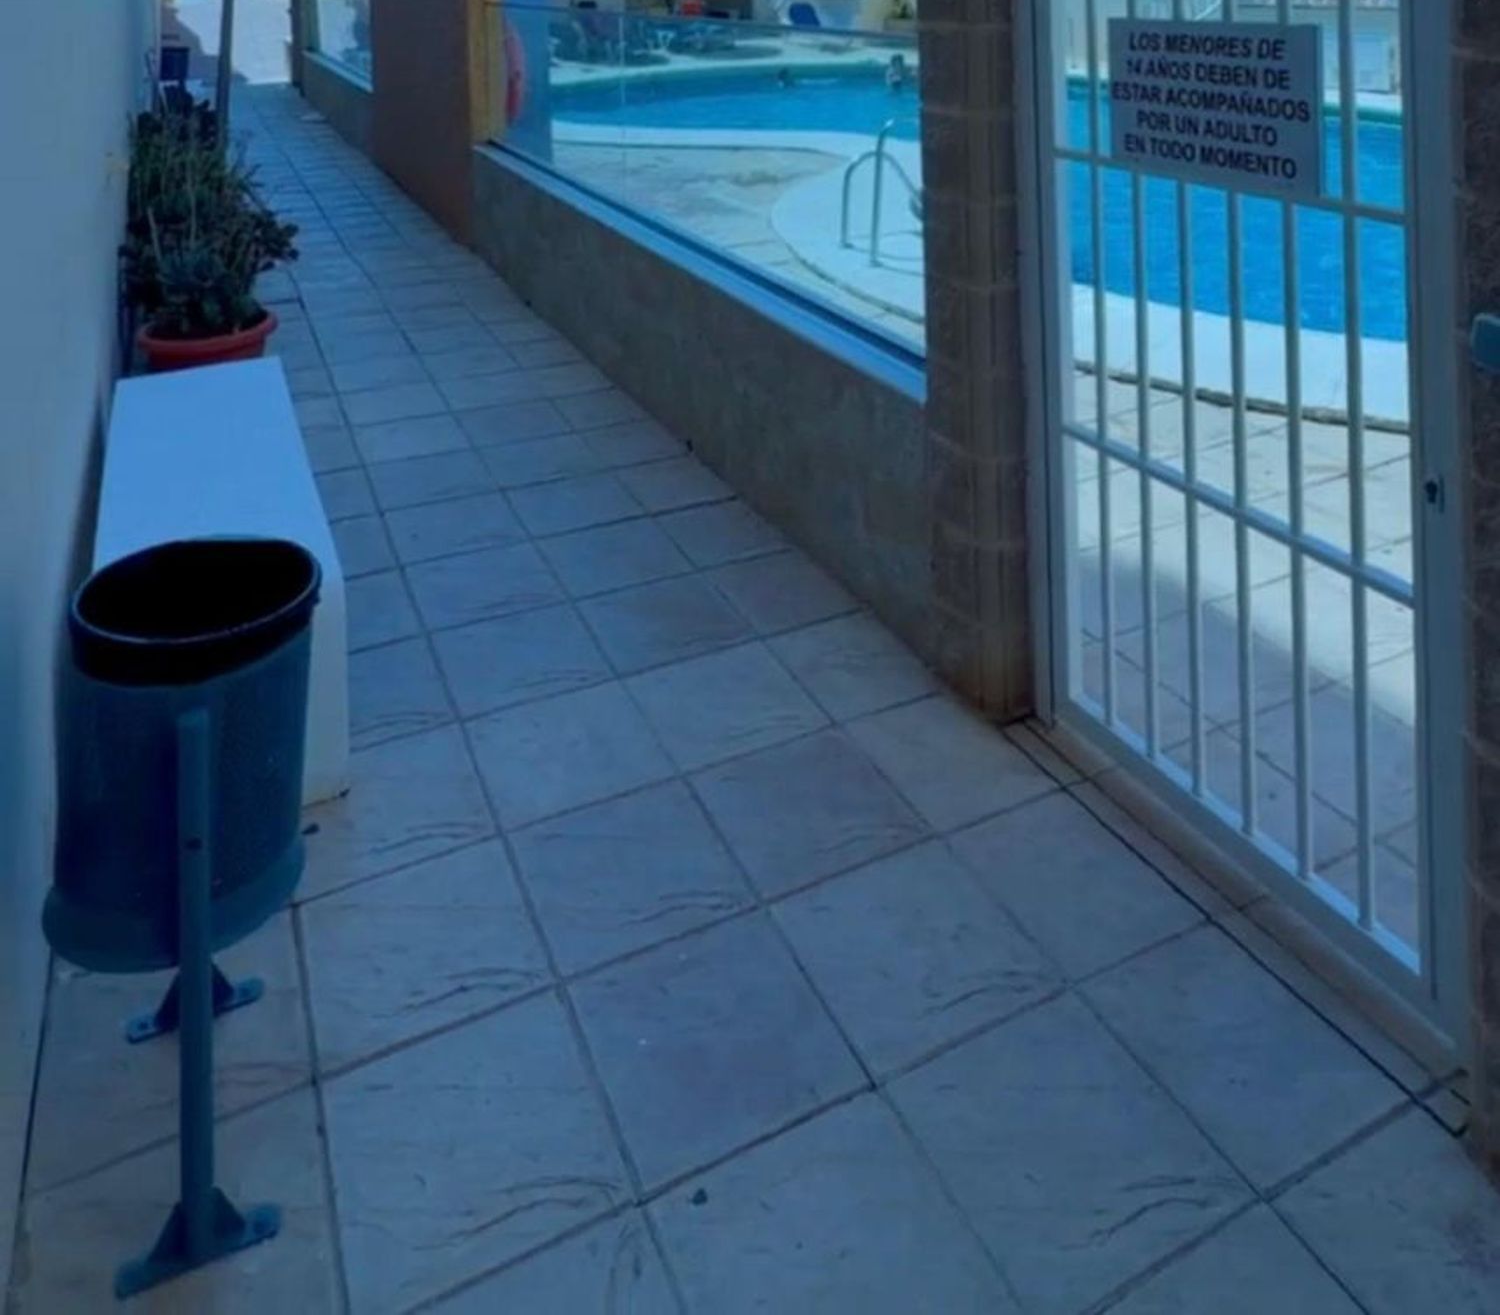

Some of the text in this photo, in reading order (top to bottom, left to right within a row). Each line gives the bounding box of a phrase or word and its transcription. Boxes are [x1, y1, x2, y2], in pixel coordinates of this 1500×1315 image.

[1128, 33, 1286, 61] LOS MENORES DE
[1126, 57, 1291, 90] 14 AÑOS DEBEN DE
[1112, 82, 1310, 122] ESTAR ACOMPAÑADOS
[1136, 110, 1278, 147] POR UN ADULTO
[1124, 135, 1297, 180] EN TODO MOMENTO
